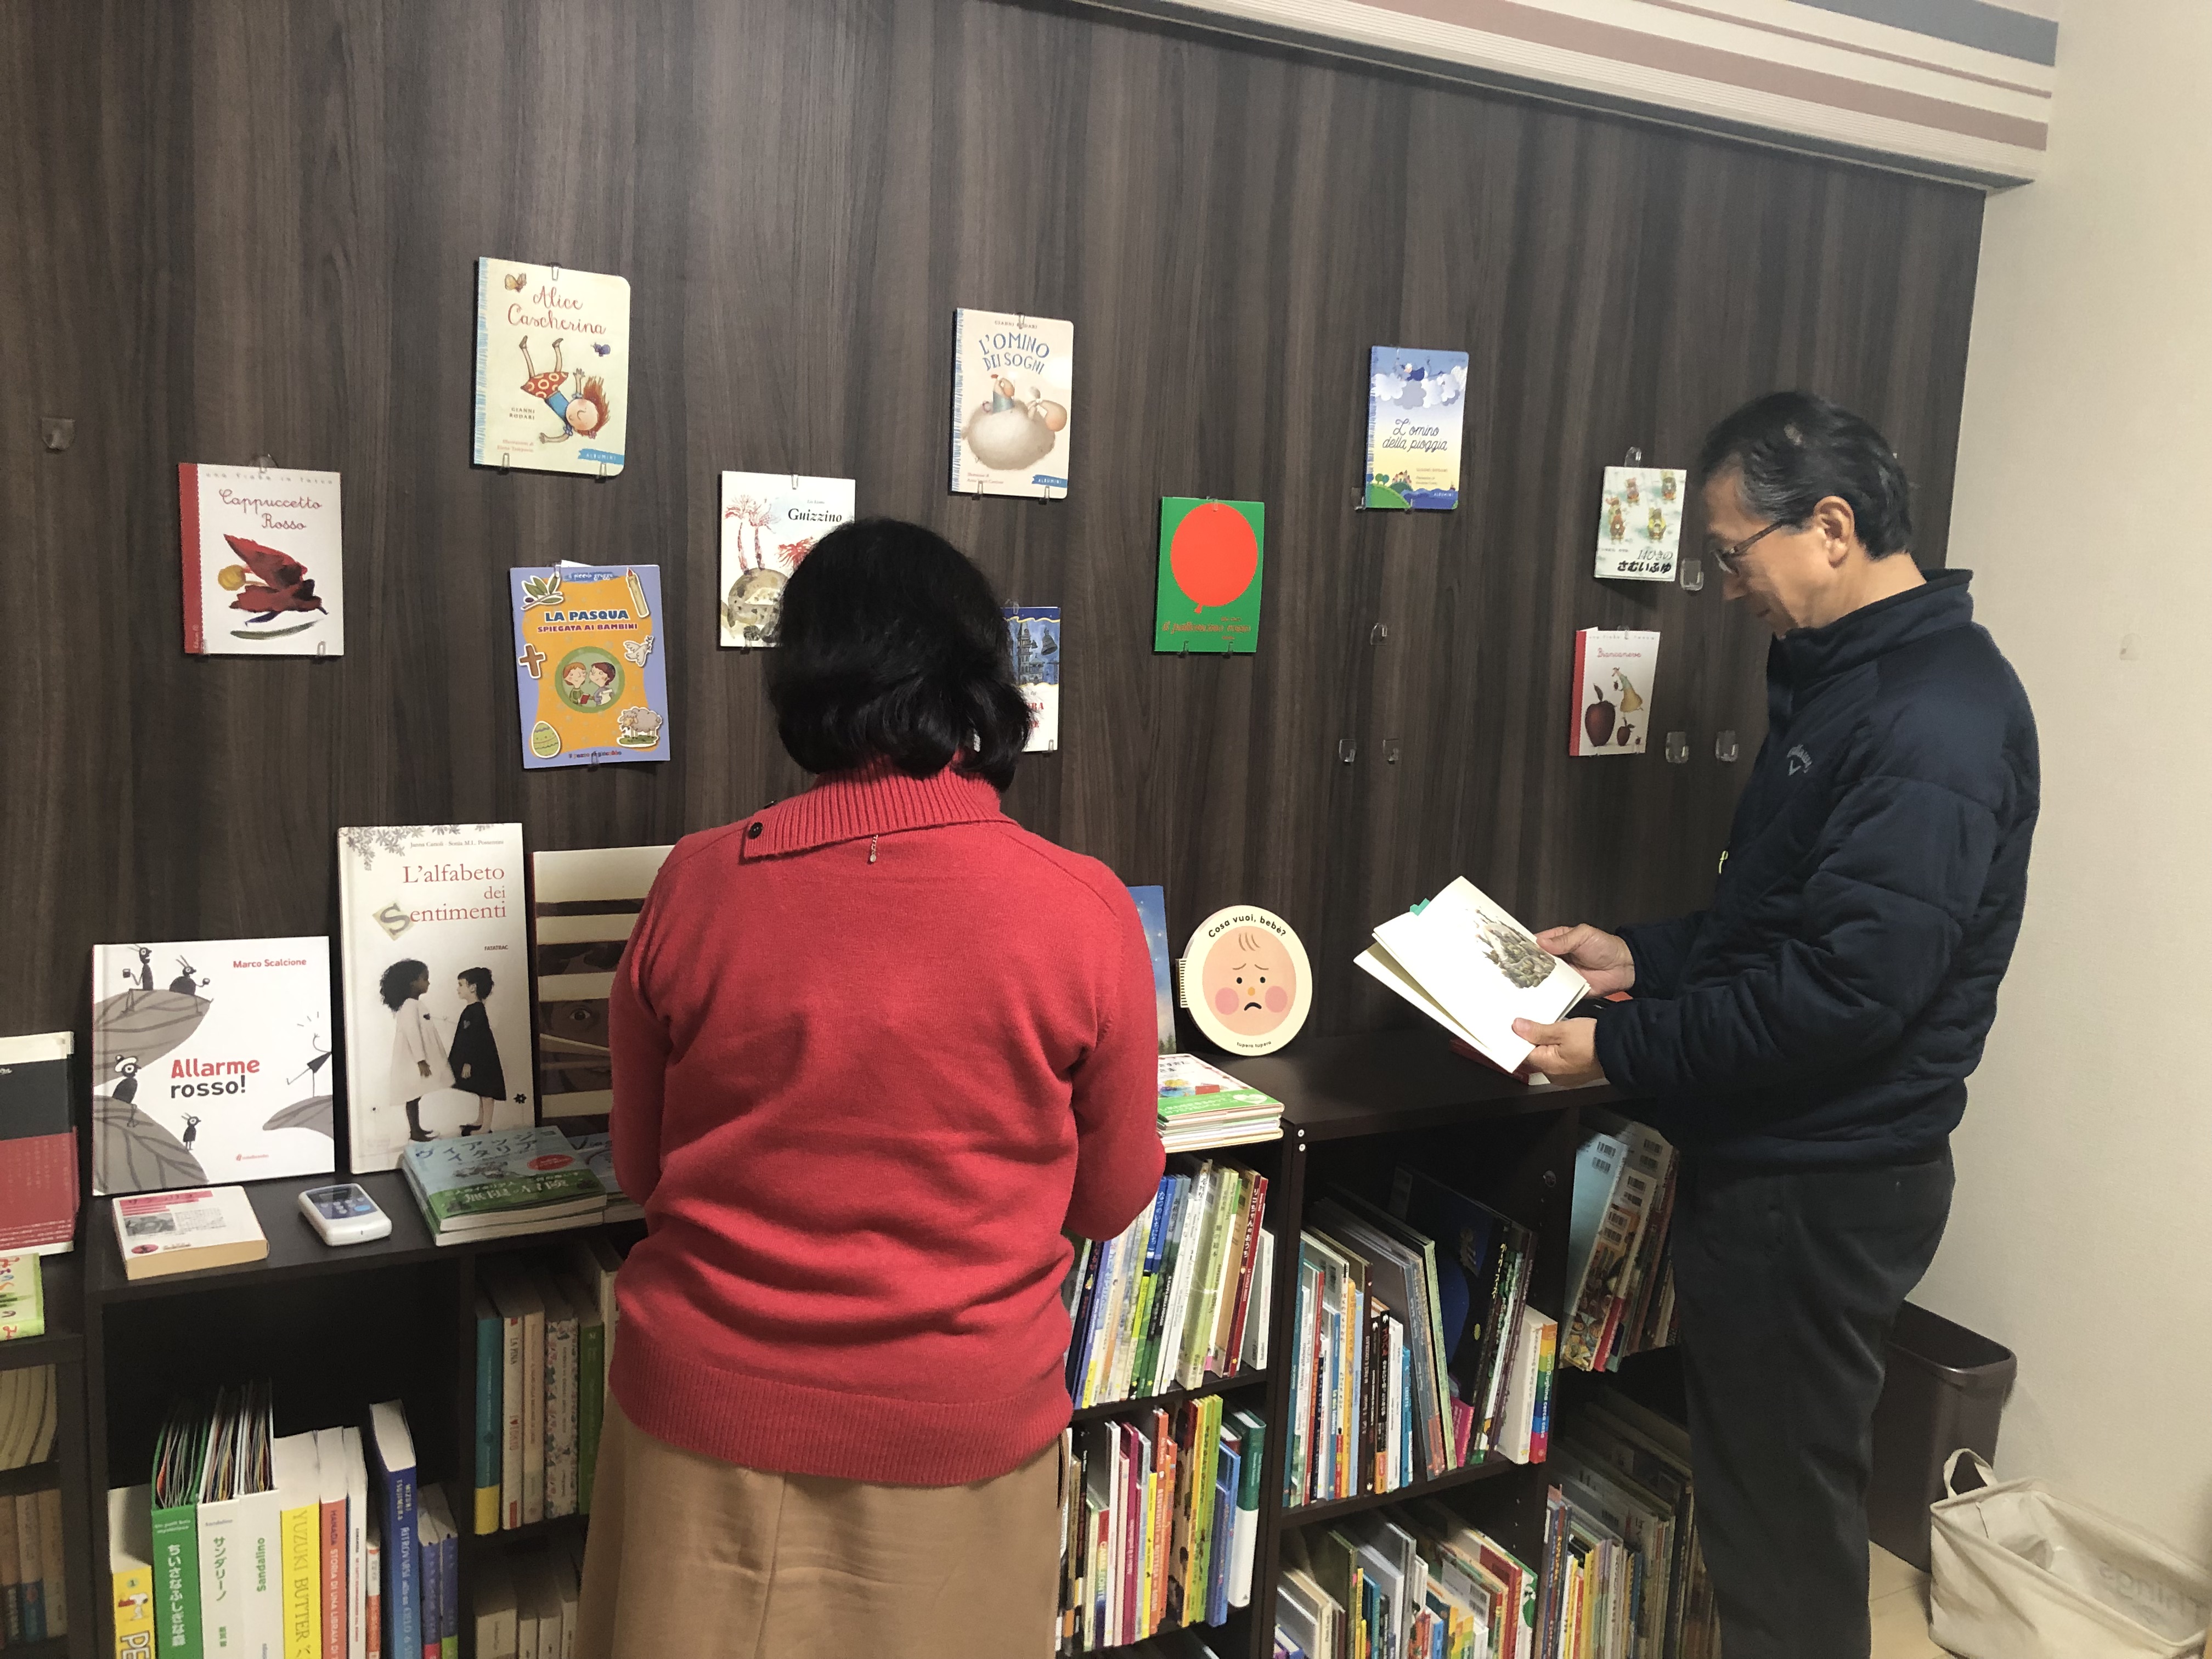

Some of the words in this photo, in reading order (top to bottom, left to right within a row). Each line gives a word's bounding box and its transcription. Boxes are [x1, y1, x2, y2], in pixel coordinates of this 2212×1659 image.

[533, 286, 583, 311] Alice
[507, 303, 606, 335] Cascherina
[979, 332, 1050, 358] L'OMINO
[983, 354, 1001, 372] DEI
[1004, 352, 1045, 375] SOGNI
[1392, 419, 1440, 437] L'omino
[1382, 437, 1407, 450] della
[1407, 437, 1448, 453] pioggia
[218, 489, 323, 515] Cappuccetto
[261, 513, 307, 530] Rosso
[788, 508, 842, 523] Guizzino
[1617, 560, 1672, 574] さむいふゆ
[545, 611, 565, 623] LA
[569, 610, 629, 621] PASQUA
[596, 623, 639, 631] BAMBINI
[402, 863, 505, 883] L'alfabeto
[483, 885, 506, 899] dei
[380, 900, 507, 936] Sentimenti
[1208, 919, 1231, 938] Cosa
[1232, 913, 1256, 923] vuoi,
[233, 960, 262, 969] Marco
[263, 958, 307, 967] Scalcione
[171, 1058, 261, 1079] Allarme
[170, 1075, 246, 1099] rosso!
[293, 1510, 308, 1571] YUZUKI
[213, 1536, 227, 1601] サンダリーノ
[256, 1537, 267, 1593] Sandalino
[330, 1549, 338, 1578] STORIA
[129, 1579, 136, 1587] 1
[330, 1581, 337, 1590] DI
[294, 1578, 309, 1642] BUTTER
[330, 1611, 338, 1643] LIBRAIA
